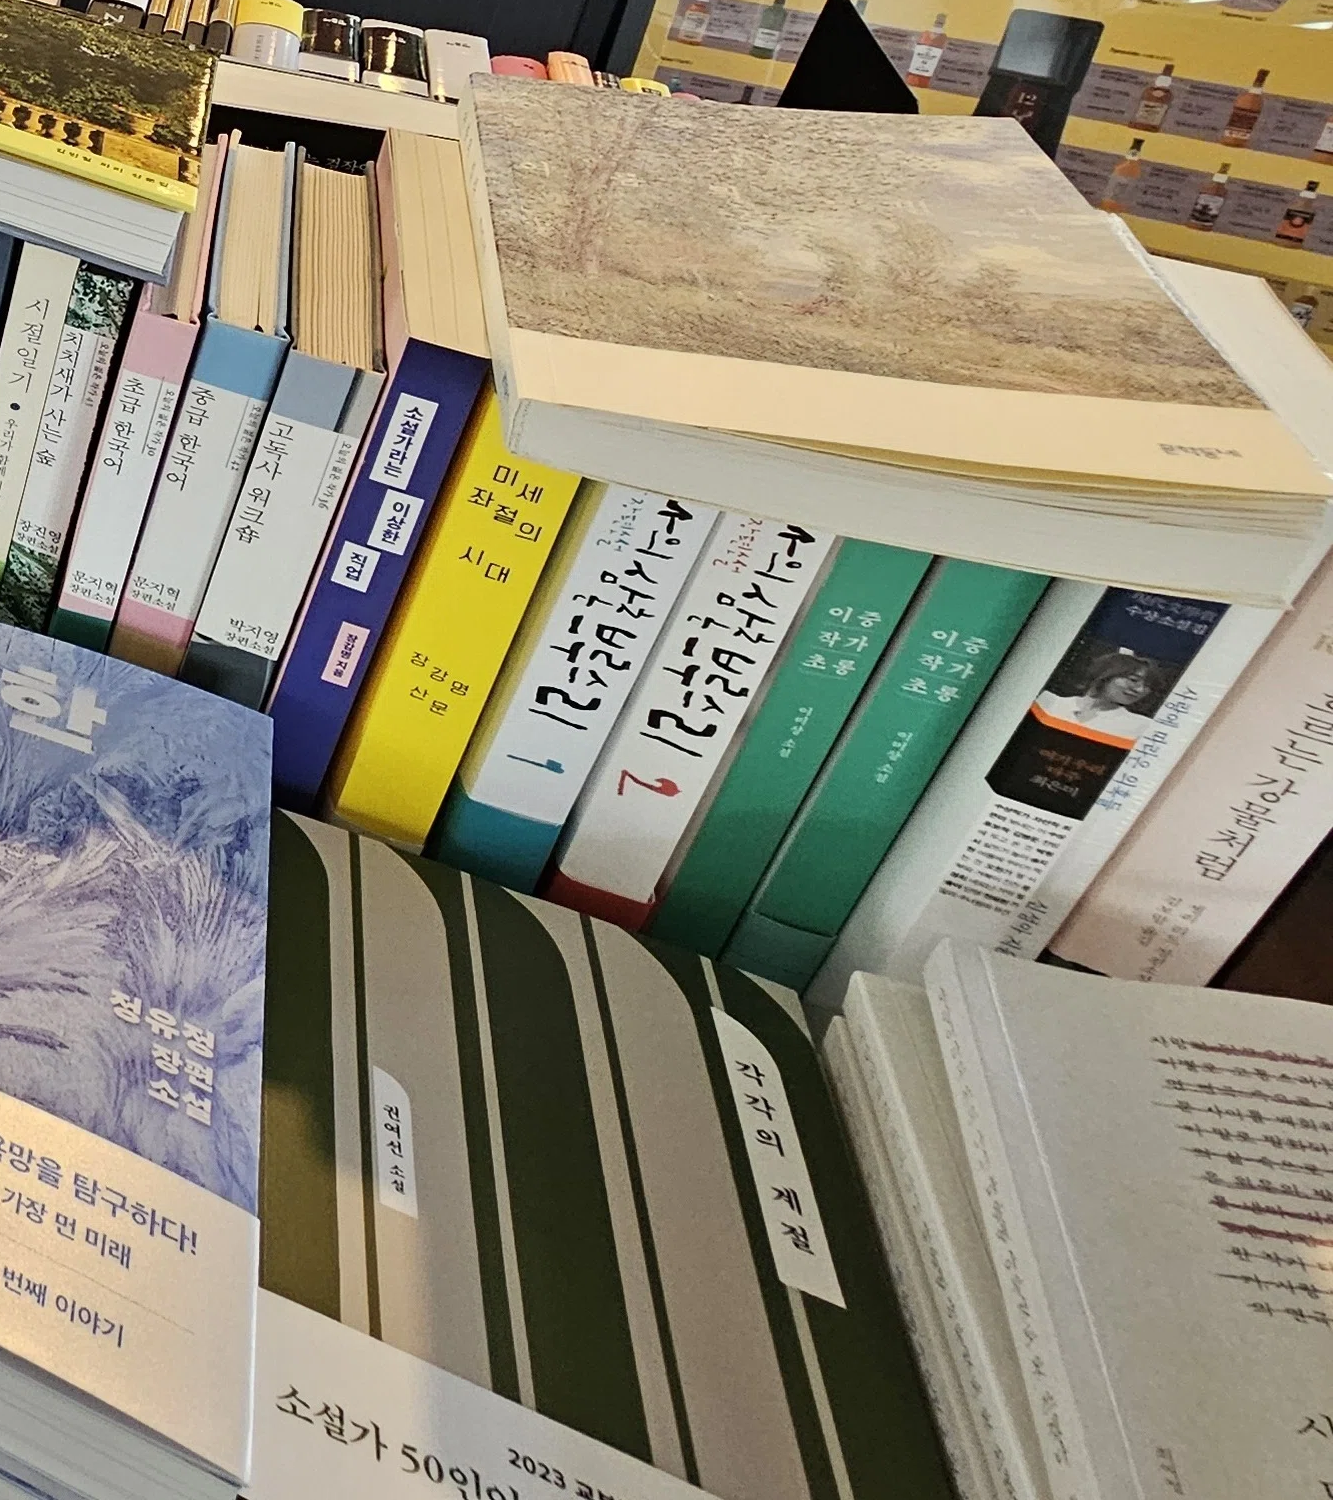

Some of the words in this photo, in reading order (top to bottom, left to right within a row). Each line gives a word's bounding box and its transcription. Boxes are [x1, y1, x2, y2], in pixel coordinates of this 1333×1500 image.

[50, 332, 83, 403] 치치새가
[118, 377, 145, 415] 초급
[185, 385, 215, 427] 중급
[0, 418, 18, 452] 우리가
[42, 409, 67, 444] 사는
[103, 420, 135, 476] 한국어
[383, 405, 424, 478] 소설가라는
[35, 449, 56, 467] 숲
[166, 434, 201, 492] 한국어
[255, 420, 294, 481] 고독사
[492, 465, 545, 505] 미세
[235, 486, 272, 544] 워크숍
[381, 501, 412, 545] 이상한
[466, 486, 543, 543] 좌절의
[71, 569, 118, 595] 문지혁
[345, 551, 369, 582] 직업
[458, 545, 511, 584] 시대
[229, 617, 279, 644] 박지영
[829, 606, 882, 628] 이중
[818, 630, 869, 652] 작가
[410, 651, 470, 696] 장강명
[802, 653, 856, 676] 초롱
[409, 685, 449, 716] 산문
[1155, 686, 1198, 728] 사랑에
[1126, 730, 1168, 769] 따라온
[1096, 772, 1139, 811] 의혹들
[1196, 773, 1300, 881] 강물처럼
[109, 984, 216, 1059] 정유정
[381, 1102, 405, 1160] 권여선
[735, 1059, 786, 1160] 각각의
[770, 1183, 816, 1256] 계절
[1, 1180, 49, 1226] 가장
[51, 1209, 80, 1242] 먼
[82, 1224, 134, 1271] 미래
[70, 1169, 200, 1258] 탐구하다!
[0, 1262, 49, 1310] 번째
[52, 1289, 126, 1351] 이야기
[276, 1384, 389, 1462] 소설가
[507, 1447, 567, 1491] 2023
